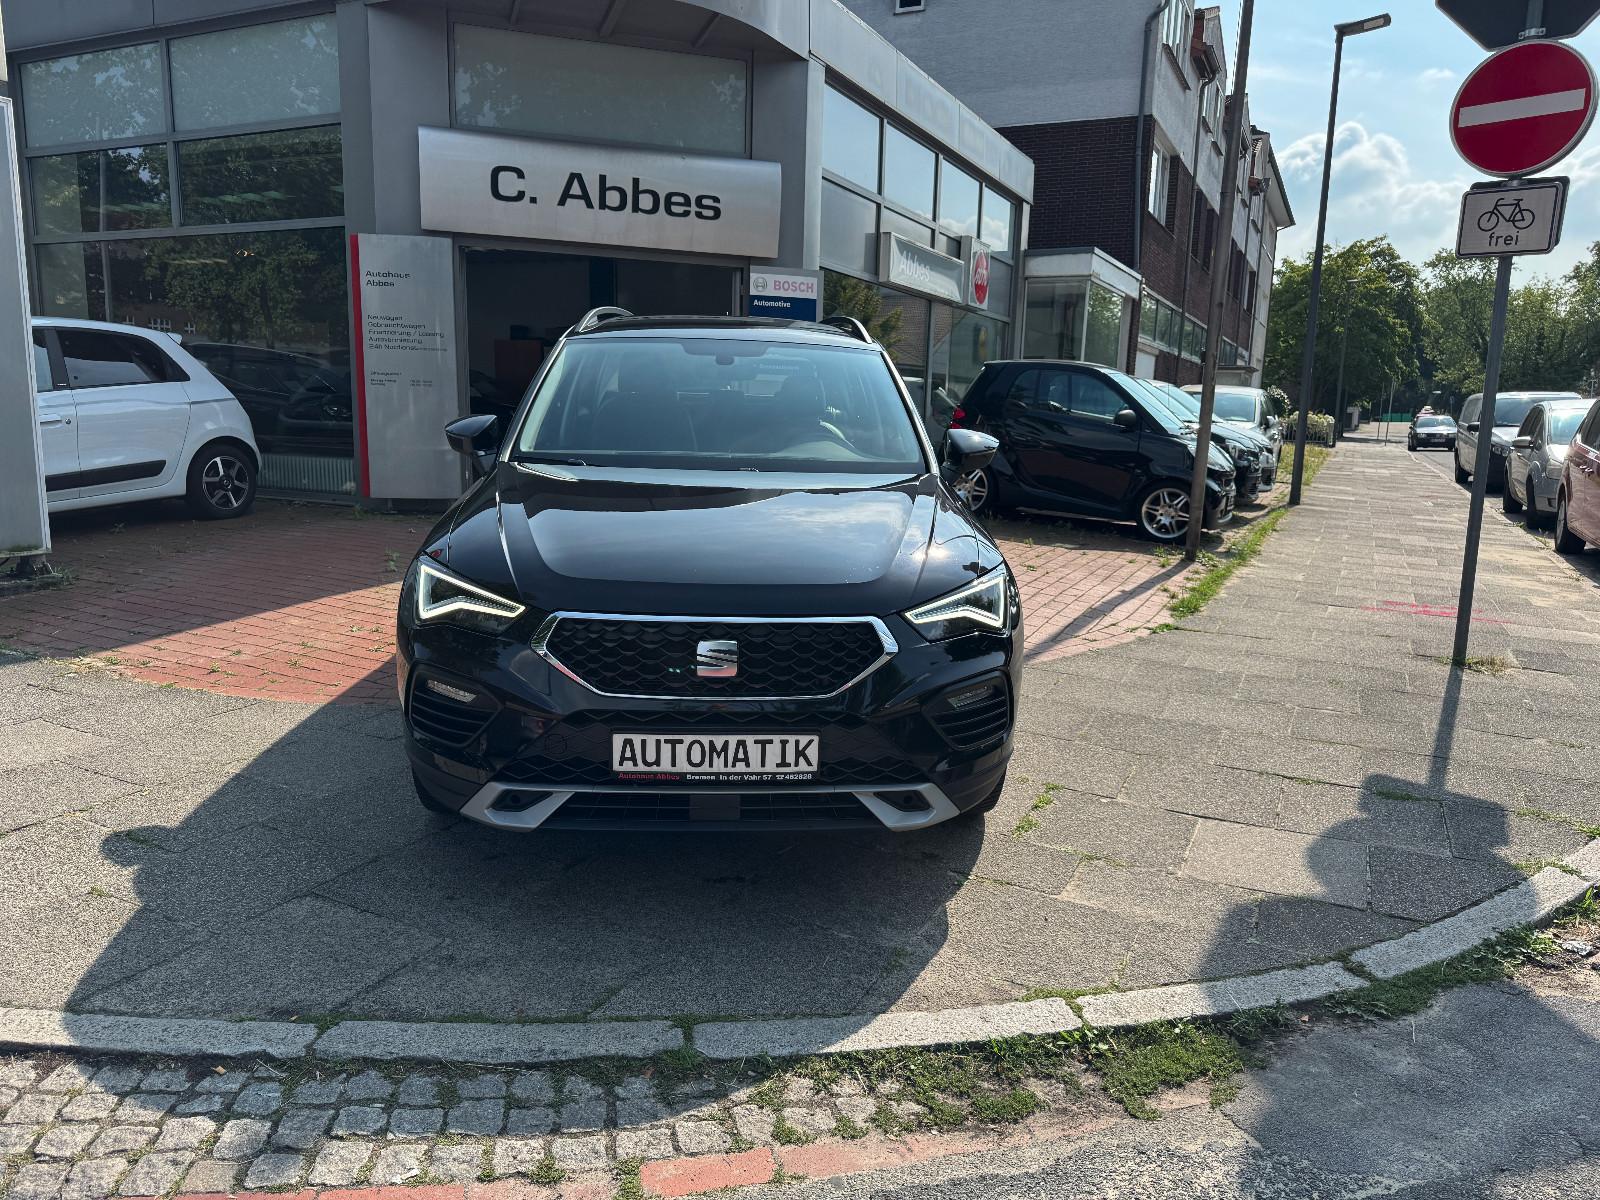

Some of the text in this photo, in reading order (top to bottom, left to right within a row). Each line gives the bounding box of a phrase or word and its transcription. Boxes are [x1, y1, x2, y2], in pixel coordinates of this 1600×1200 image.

[490, 165, 722, 221] C. Abbes
[1488, 230, 1520, 247] frei
[899, 249, 931, 282] Abbes
[773, 279, 814, 293] BOSCH
[753, 299, 791, 308] Automotive
[618, 738, 815, 769] AUTOMATIK
